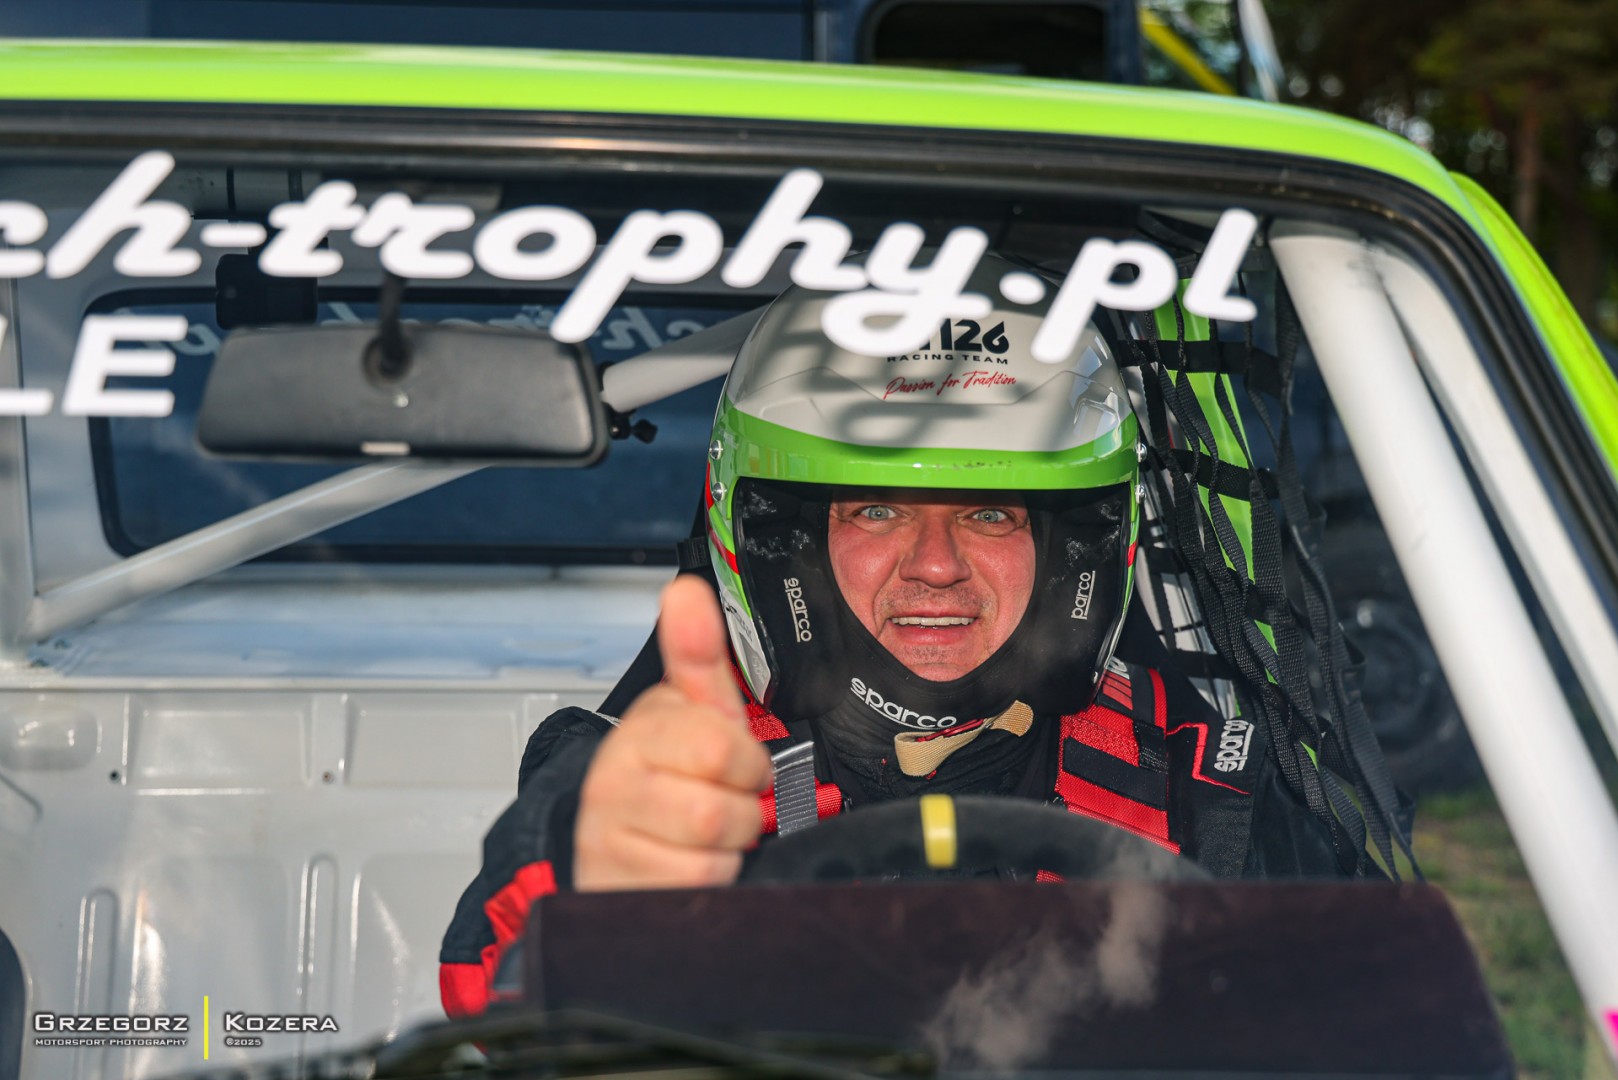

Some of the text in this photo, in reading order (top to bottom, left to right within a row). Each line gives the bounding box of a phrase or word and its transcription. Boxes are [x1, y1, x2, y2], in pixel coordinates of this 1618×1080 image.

[887, 354, 1009, 365] RACING TEAM
[883, 370, 1016, 400] Passion for Tradition
[784, 577, 812, 642] sparco
[850, 677, 957, 729] sparco
